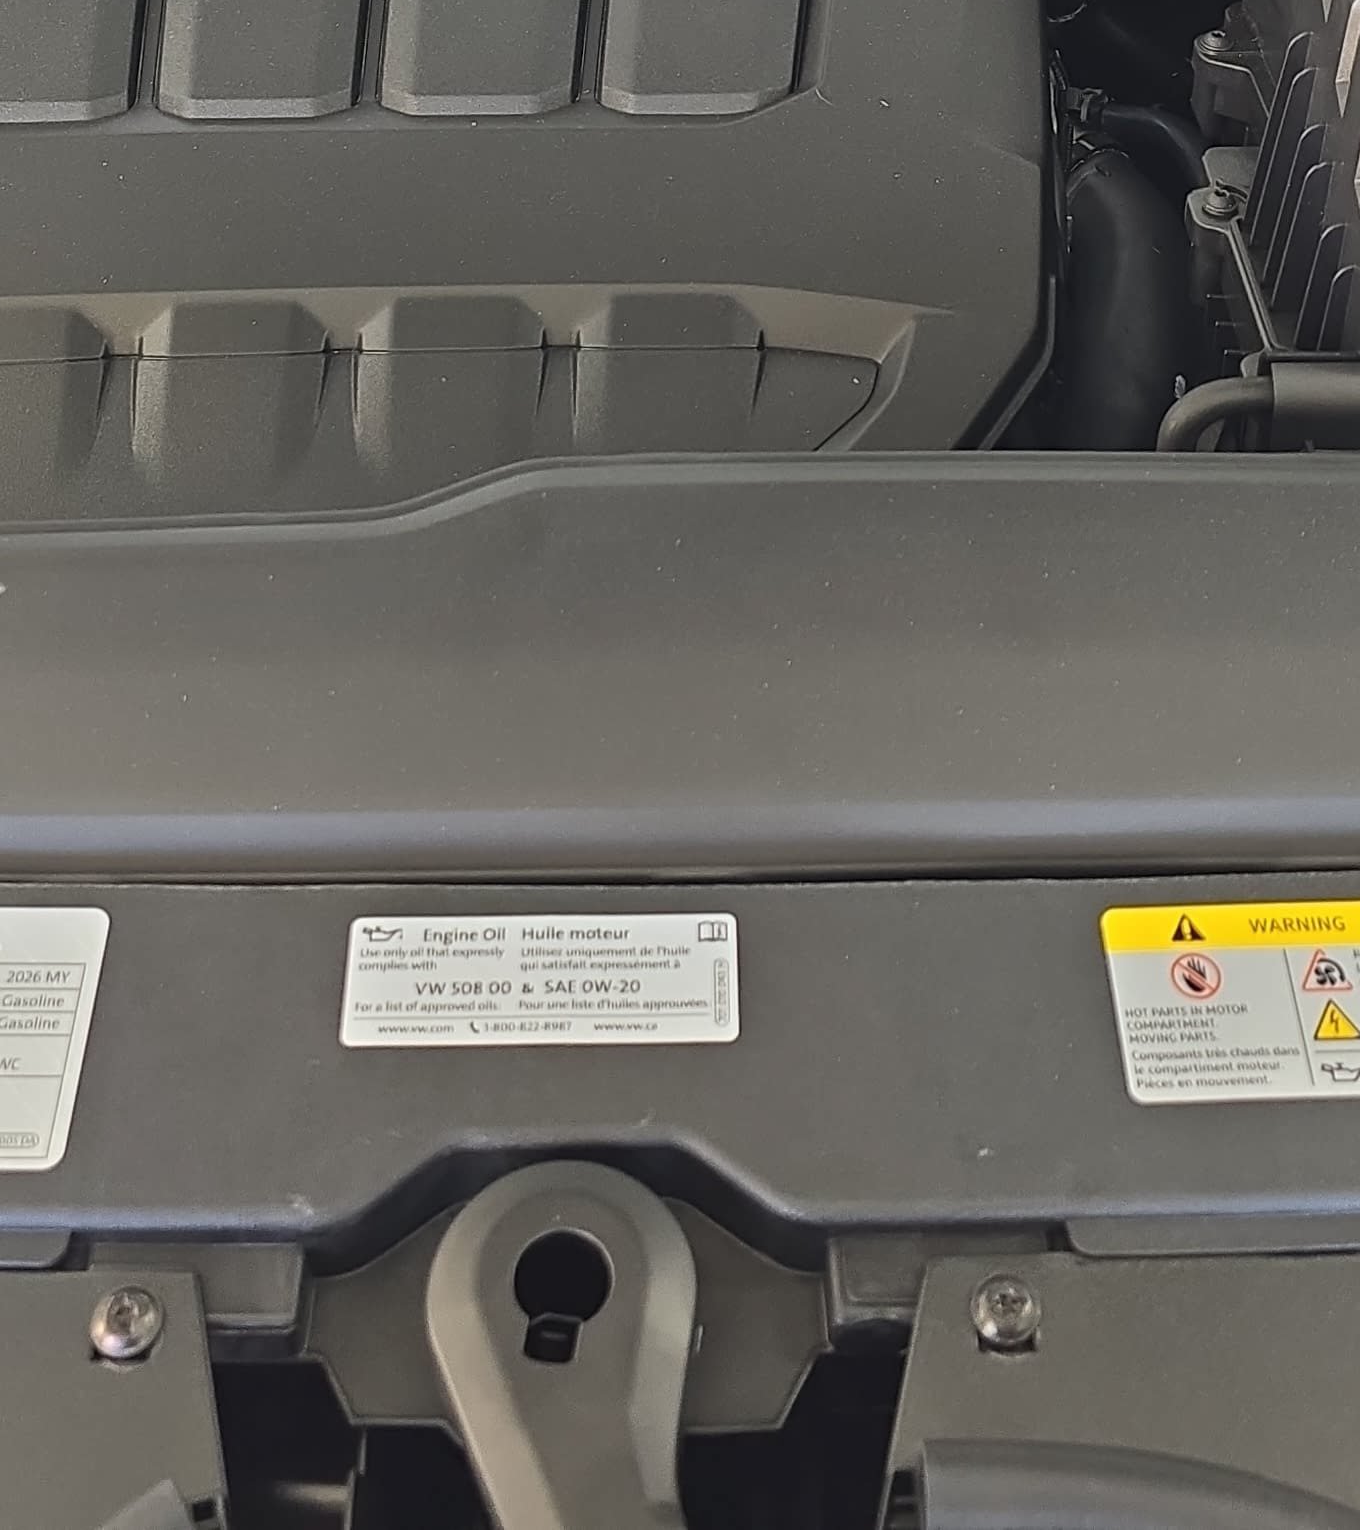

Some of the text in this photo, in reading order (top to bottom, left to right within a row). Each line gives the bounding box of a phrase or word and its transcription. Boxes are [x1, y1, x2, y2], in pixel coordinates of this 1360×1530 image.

[1249, 917, 1346, 934] WARNING
[423, 927, 506, 945] Engine Oil
[522, 927, 630, 941] Huile moteur
[360, 945, 505, 959] Use only oil that expressly
[521, 947, 562, 957] Utilisez
[567, 946, 636, 959] uniquement
[640, 946, 654, 956] de
[358, 959, 437, 972] complies with
[520, 961, 539, 972] qui
[541, 960, 587, 970] satisfait
[6, 970, 72, 984] 2026 MY
[415, 979, 641, 996] VW 508 00 & SAE 0W-20
[1, 993, 65, 1008] Gasoline
[355, 1002, 373, 1012] For
[385, 1001, 403, 1012] list
[405, 1000, 418, 1012] of
[421, 1001, 476, 1014] approved
[519, 1000, 545, 1011] Pour
[547, 1001, 569, 1010] une
[571, 999, 593, 1010] liste
[1125, 1003, 1249, 1018] HOT PARTS IN MOTOR
[378, 1025, 455, 1034] www.vw.com
[593, 1022, 658, 1031] www.vw.ca
[1129, 1032, 1178, 1044] MOVING
[1131, 1048, 1204, 1062] Composants
[1230, 1046, 1270, 1058] chauds
[1272, 1045, 1301, 1057] dans
